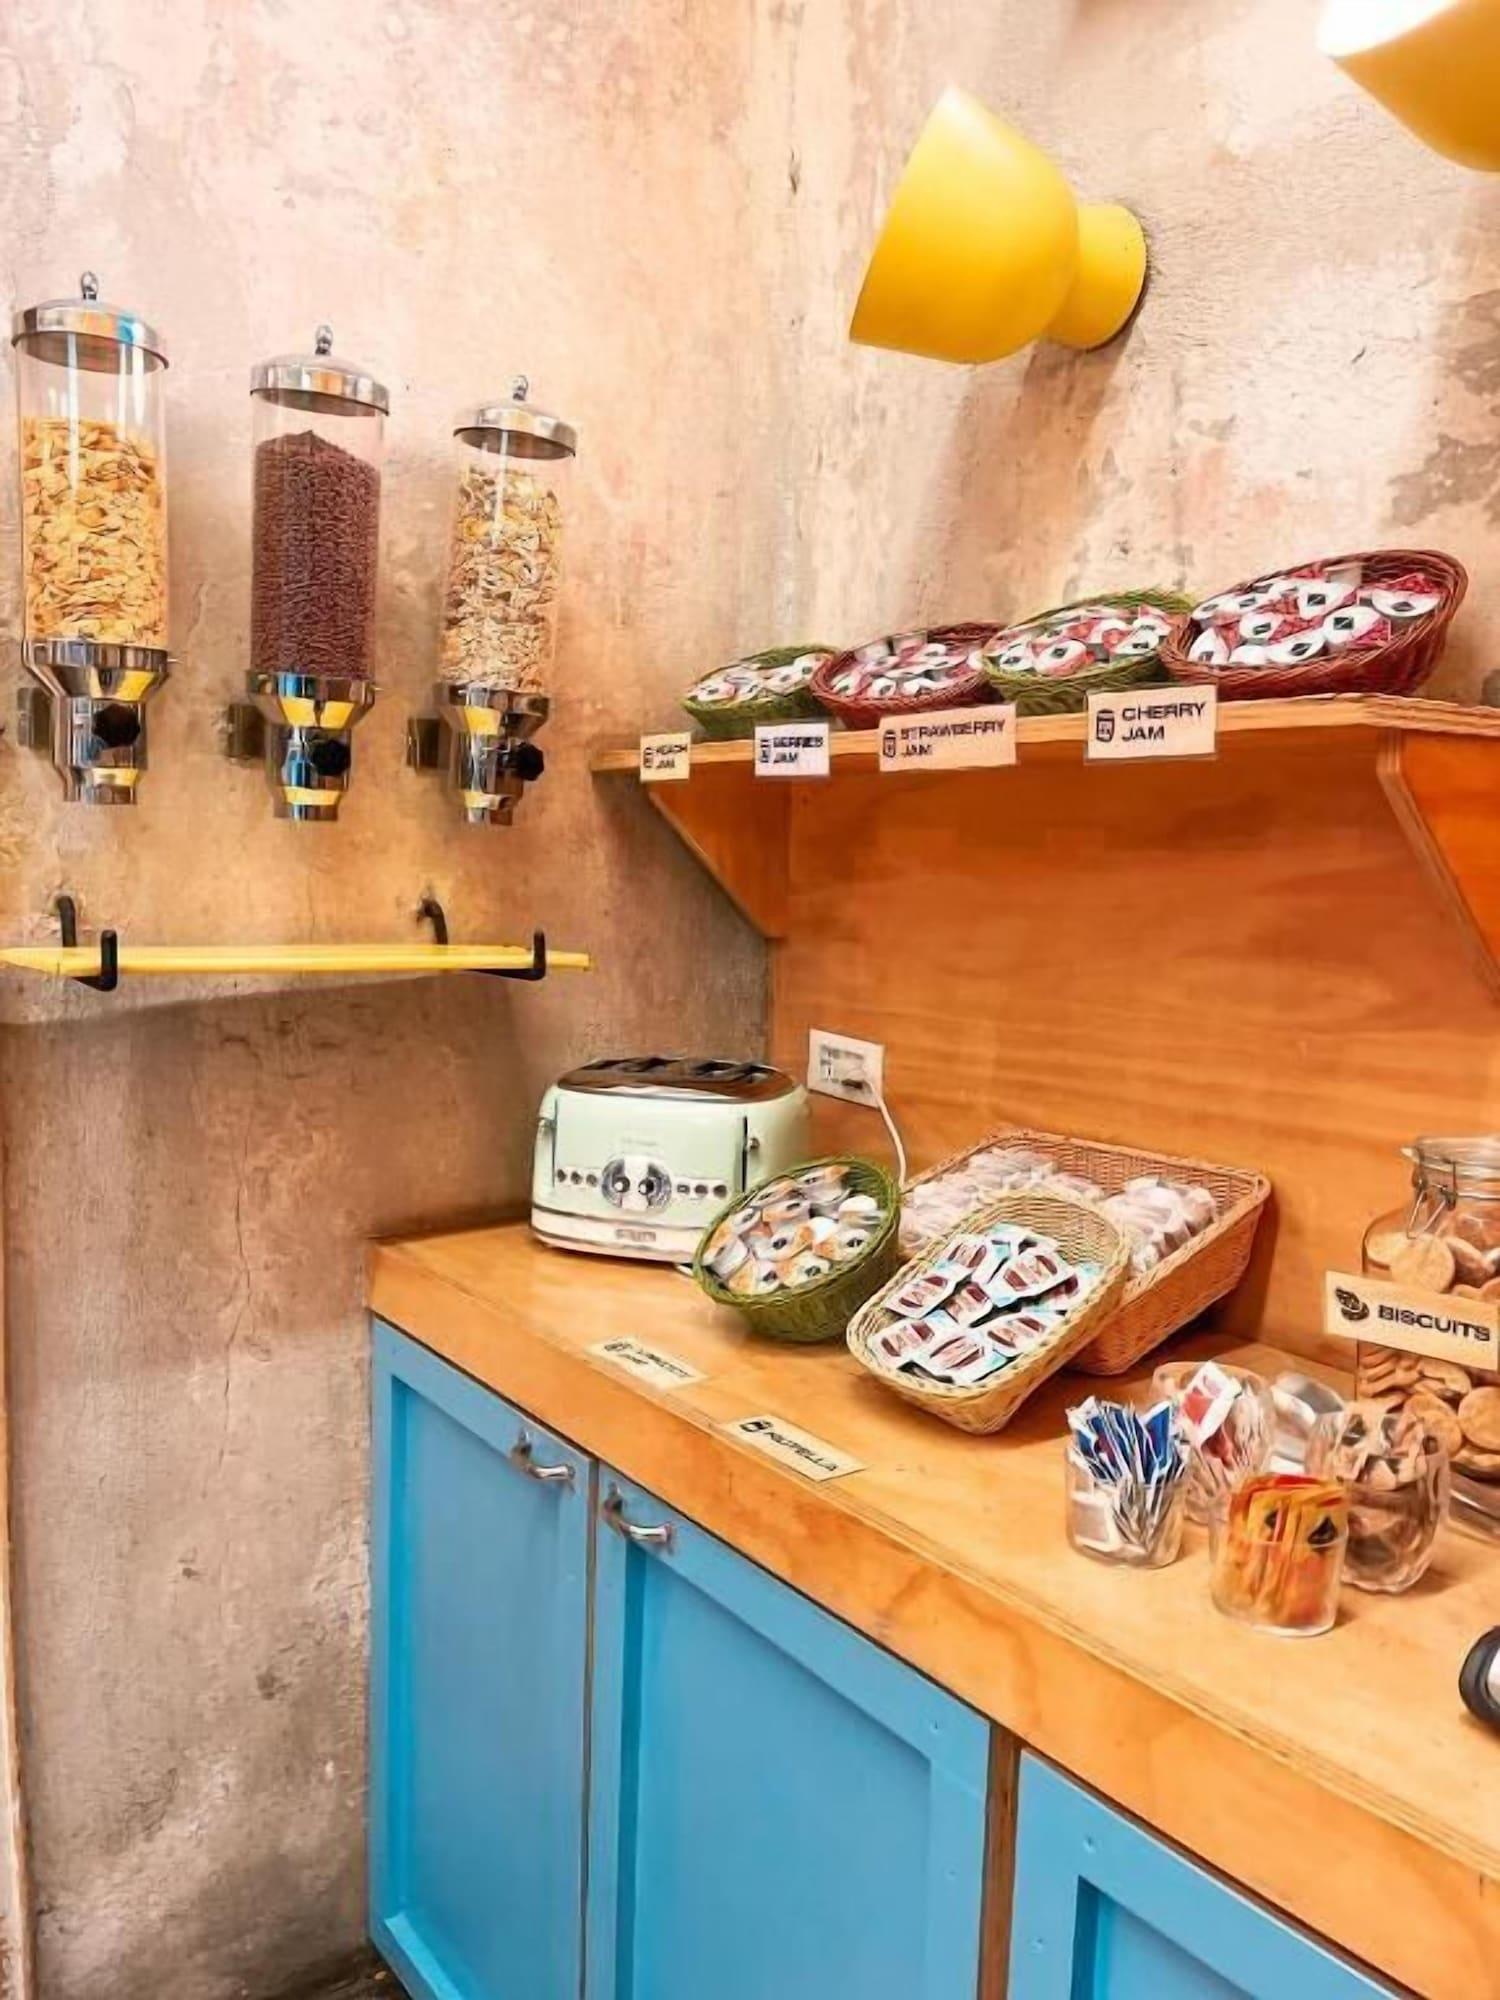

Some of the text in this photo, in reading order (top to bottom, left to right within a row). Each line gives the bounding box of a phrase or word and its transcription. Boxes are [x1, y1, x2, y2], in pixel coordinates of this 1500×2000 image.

[1121, 701, 1206, 721] CHERRY
[900, 719, 1006, 739] STRAWBERRY
[1121, 725, 1165, 742] JAM
[1377, 1304, 1491, 1342] BISCUITS
